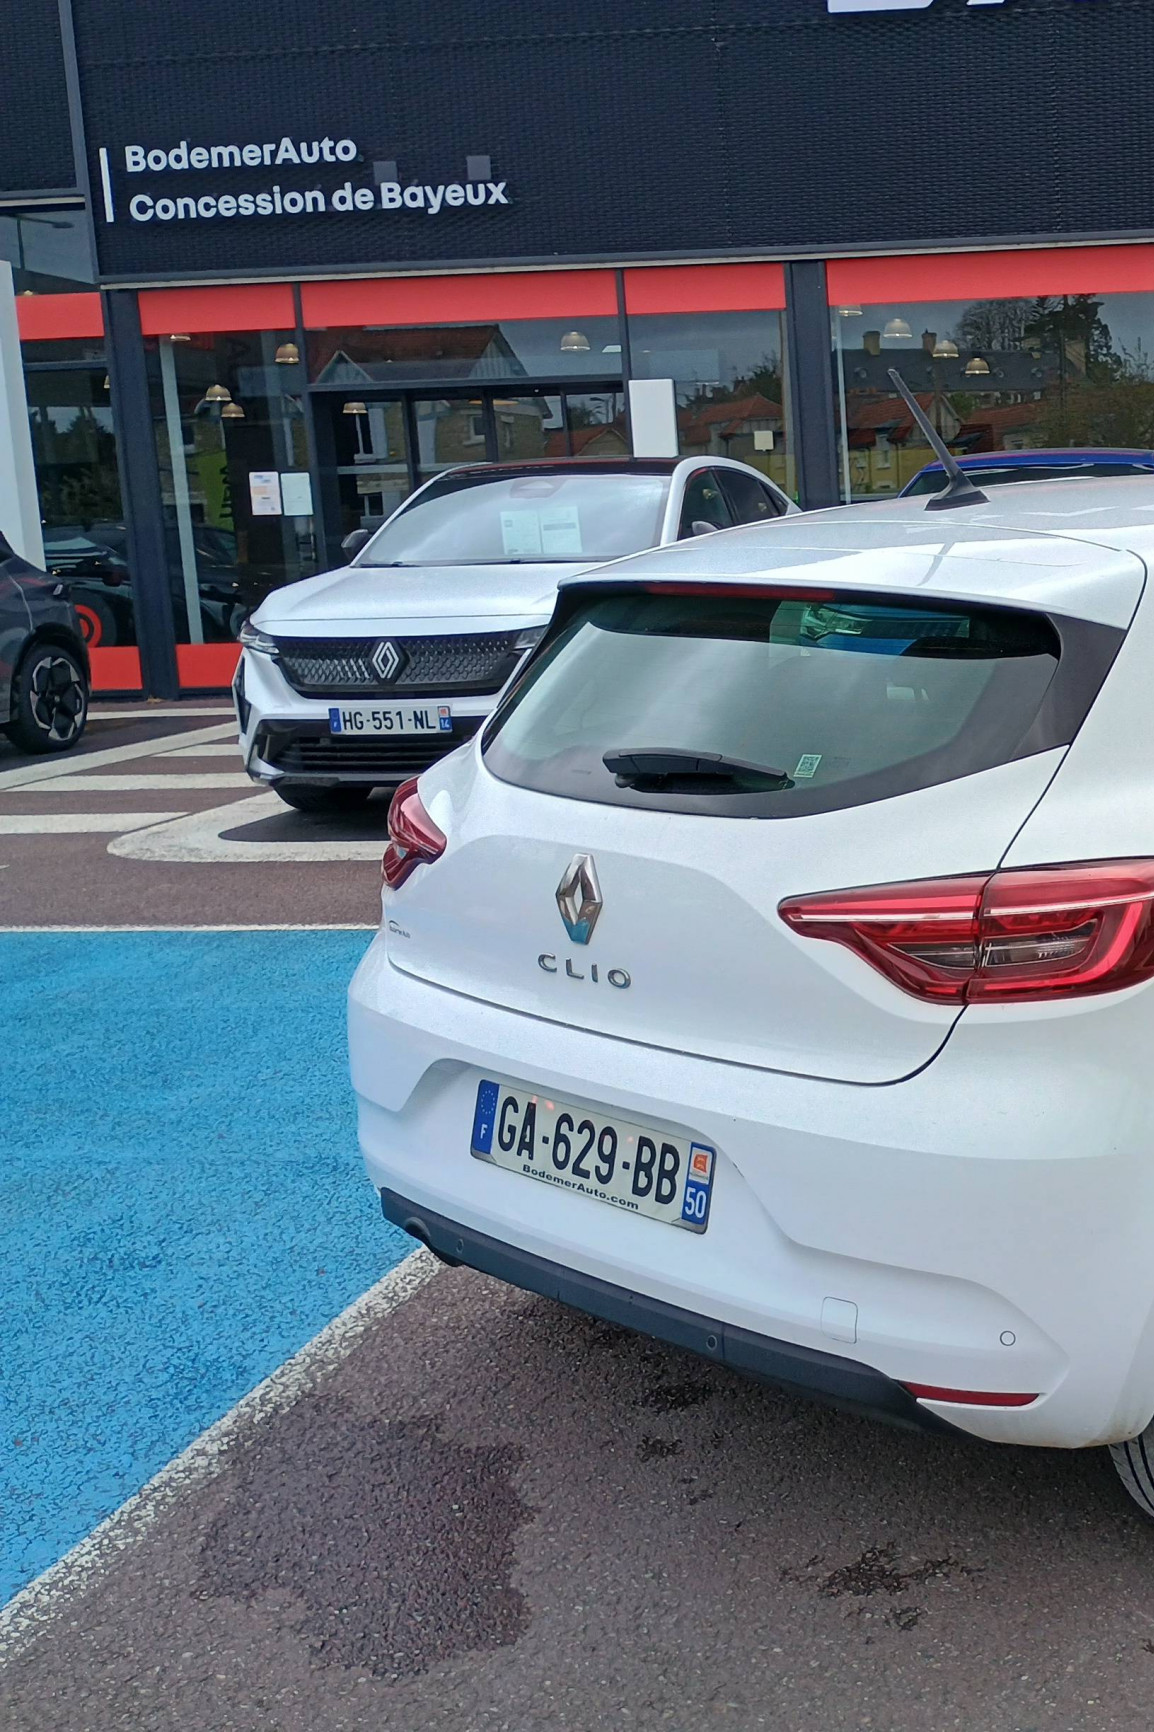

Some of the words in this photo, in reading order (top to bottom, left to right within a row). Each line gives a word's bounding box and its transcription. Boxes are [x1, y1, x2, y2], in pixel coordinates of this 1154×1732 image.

[124, 137, 358, 172] BodemerAuto
[129, 185, 326, 222] Concession
[332, 182, 375, 211] de
[380, 181, 509, 214] Bayeux
[342, 710, 436, 730] HG-551-NL
[537, 953, 632, 989] CLIO
[480, 1123, 488, 1139] F
[497, 1096, 681, 1205] GA-629-BB
[522, 1163, 640, 1210] BodemerAuto.com
[684, 1187, 707, 1219] 50
